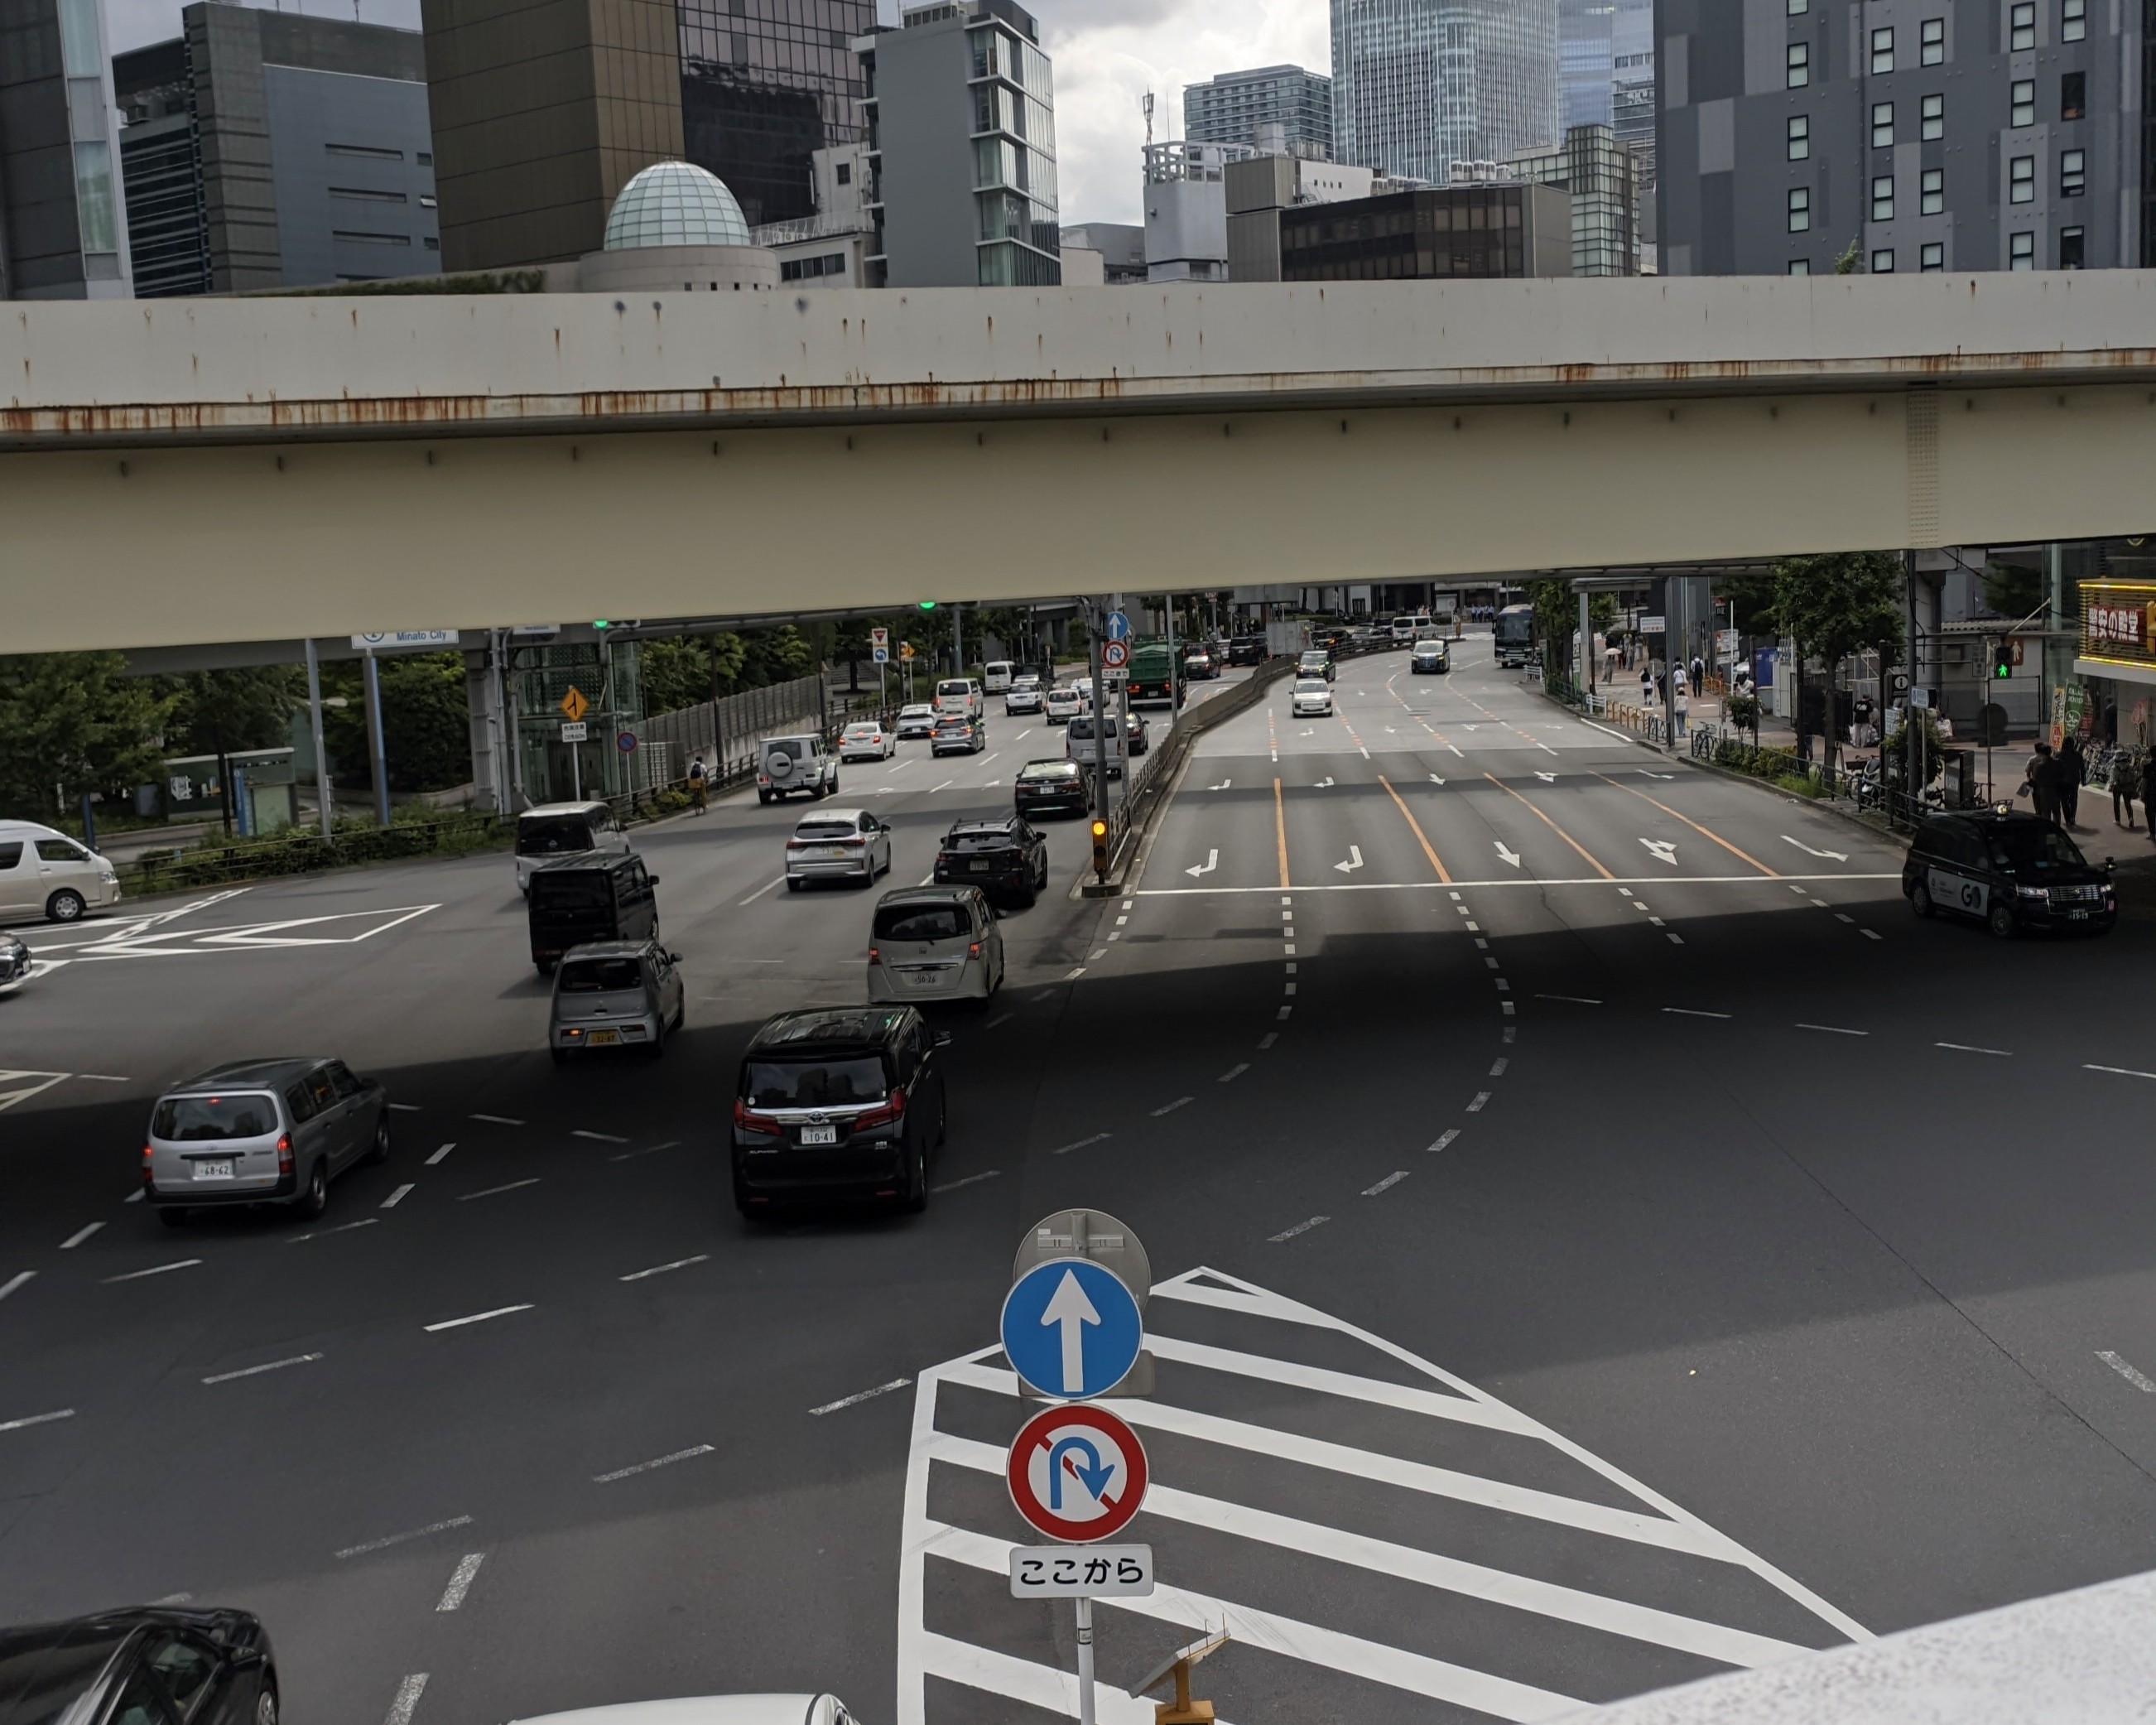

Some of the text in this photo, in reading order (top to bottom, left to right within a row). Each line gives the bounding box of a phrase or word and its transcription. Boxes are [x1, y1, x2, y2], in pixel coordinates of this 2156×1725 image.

[397, 630, 447, 641] Minato City
[810, 1132, 833, 1143] 10-41
[205, 1166, 229, 1175] 68-62
[1021, 1558, 1143, 1585] ここから
